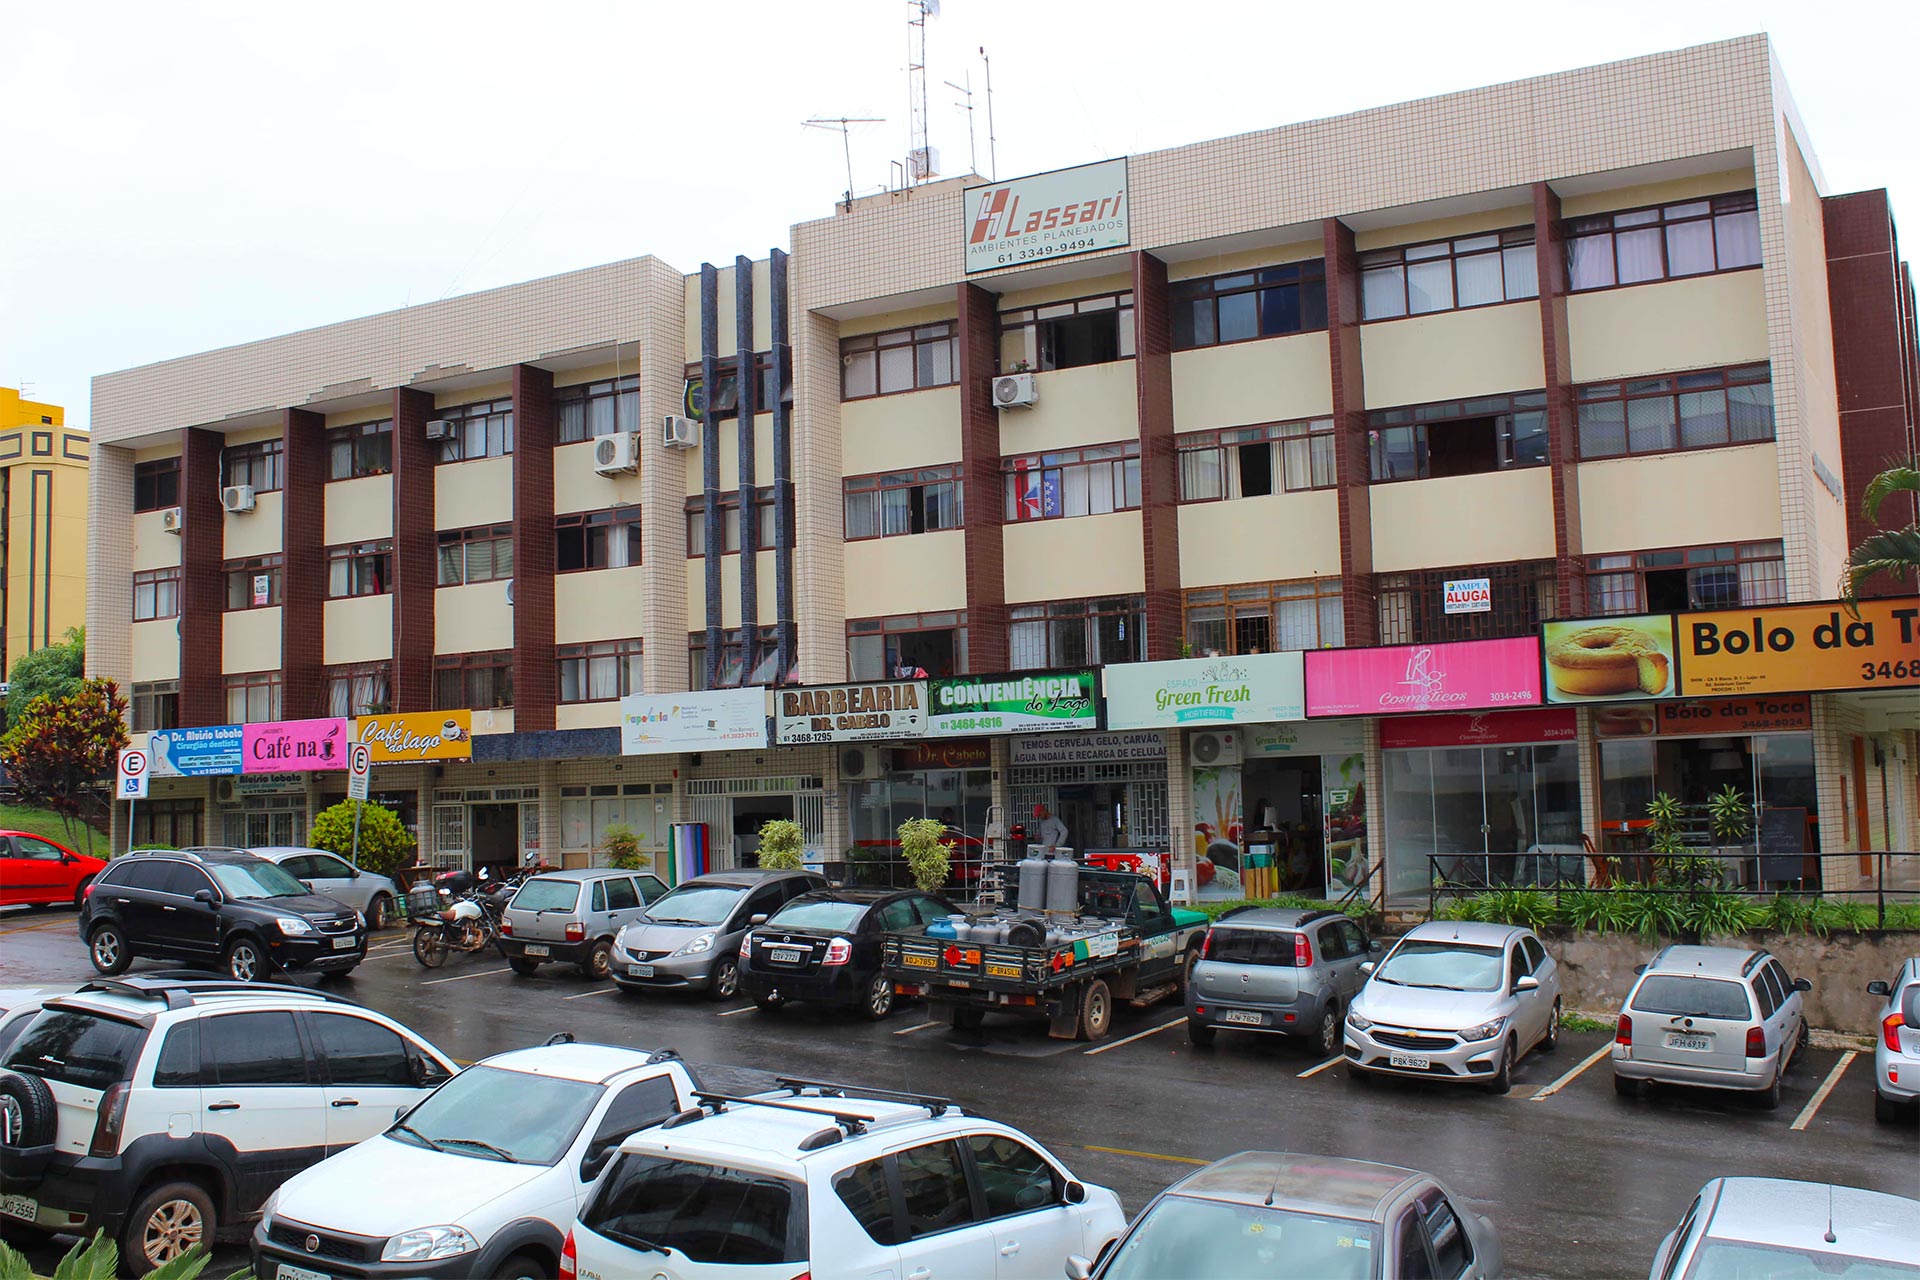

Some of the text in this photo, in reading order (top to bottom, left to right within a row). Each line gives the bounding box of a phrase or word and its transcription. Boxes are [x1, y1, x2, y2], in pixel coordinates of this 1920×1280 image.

[1005, 190, 1123, 237] Lassari
[971, 219, 1123, 255] AMBIENTES PLANEJADOS
[998, 238, 1095, 263] 61 3349-9494
[1456, 582, 1488, 590] AMPLA
[1446, 590, 1489, 603] ALUGA
[1692, 608, 1920, 656] Bolo da T
[1166, 679, 1198, 688] ESPAÇO
[940, 677, 1082, 706] CONVENIÊNCIA
[1155, 684, 1250, 711] Green Fresh
[1490, 691, 1532, 702] 3034-2496
[782, 684, 919, 718] BARBEARIA
[1025, 690, 1090, 717] do Lago
[1184, 710, 1226, 719] HORTIFRUTI
[1665, 701, 1805, 720] Bolo da Toca
[810, 713, 891, 732] DR. CABELO
[940, 721, 948, 730] 61
[950, 717, 1002, 730] 3468-4916
[172, 732, 184, 742] Dr.
[215, 728, 242, 739] Lobato
[360, 720, 404, 748] Café
[791, 732, 832, 743] 3468-1295
[1256, 735, 1298, 746] Green Fresh
[1544, 729, 1574, 737] 3034-2496
[176, 740, 238, 750] Cirurgião dentista
[254, 736, 317, 760] Café na
[388, 730, 441, 756] do lago
[1021, 733, 1162, 750] TEMOS: CERVEJA, GELO, CARVÃO,
[356, 752, 364, 768] E
[917, 743, 986, 768] Dr. Cabelo
[1014, 752, 1037, 762] ÁGUA
[1038, 750, 1066, 762] INDAIÁ
[1068, 751, 1074, 760] E
[1076, 750, 1115, 760] RECARGA
[1118, 748, 1128, 757] DE
[128, 756, 139, 771] E
[1242, 1014, 1260, 1023] 7829
[1669, 1038, 1706, 1048] JFH 6919
[1393, 1057, 1428, 1068] PBK 9622
[16, 1203, 34, 1218] 2556
